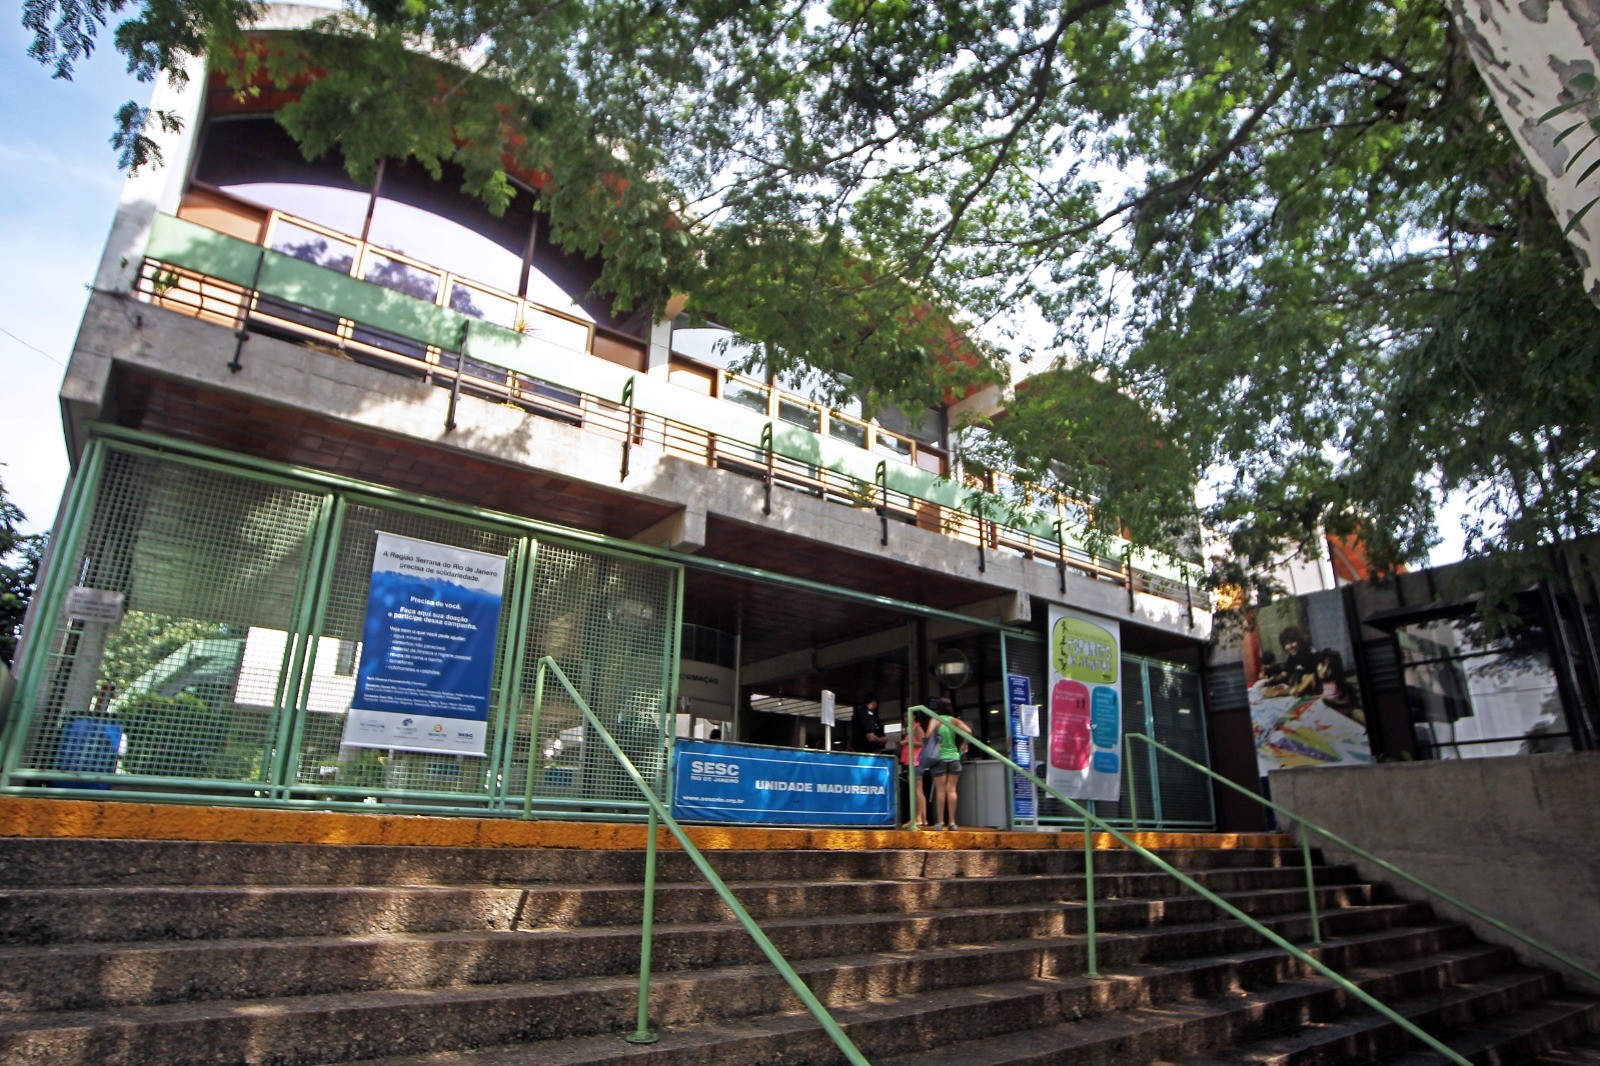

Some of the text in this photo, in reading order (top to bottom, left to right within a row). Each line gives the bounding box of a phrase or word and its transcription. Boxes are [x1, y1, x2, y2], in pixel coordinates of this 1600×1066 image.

[390, 552, 414, 562] Região
[416, 556, 440, 567] Serrana
[475, 567, 498, 577] Janeiro
[400, 562, 424, 573] precisa
[410, 596, 434, 605] Precisa
[445, 602, 462, 610] você.
[394, 612, 422, 622] participe
[424, 616, 443, 625] dessa
[400, 606, 416, 616] Faça
[417, 609, 431, 619] aqui
[680, 672, 718, 684] ORMAÇÃO
[691, 760, 739, 776] SESC
[755, 780, 885, 795] UNIDADE MADUREIRA
